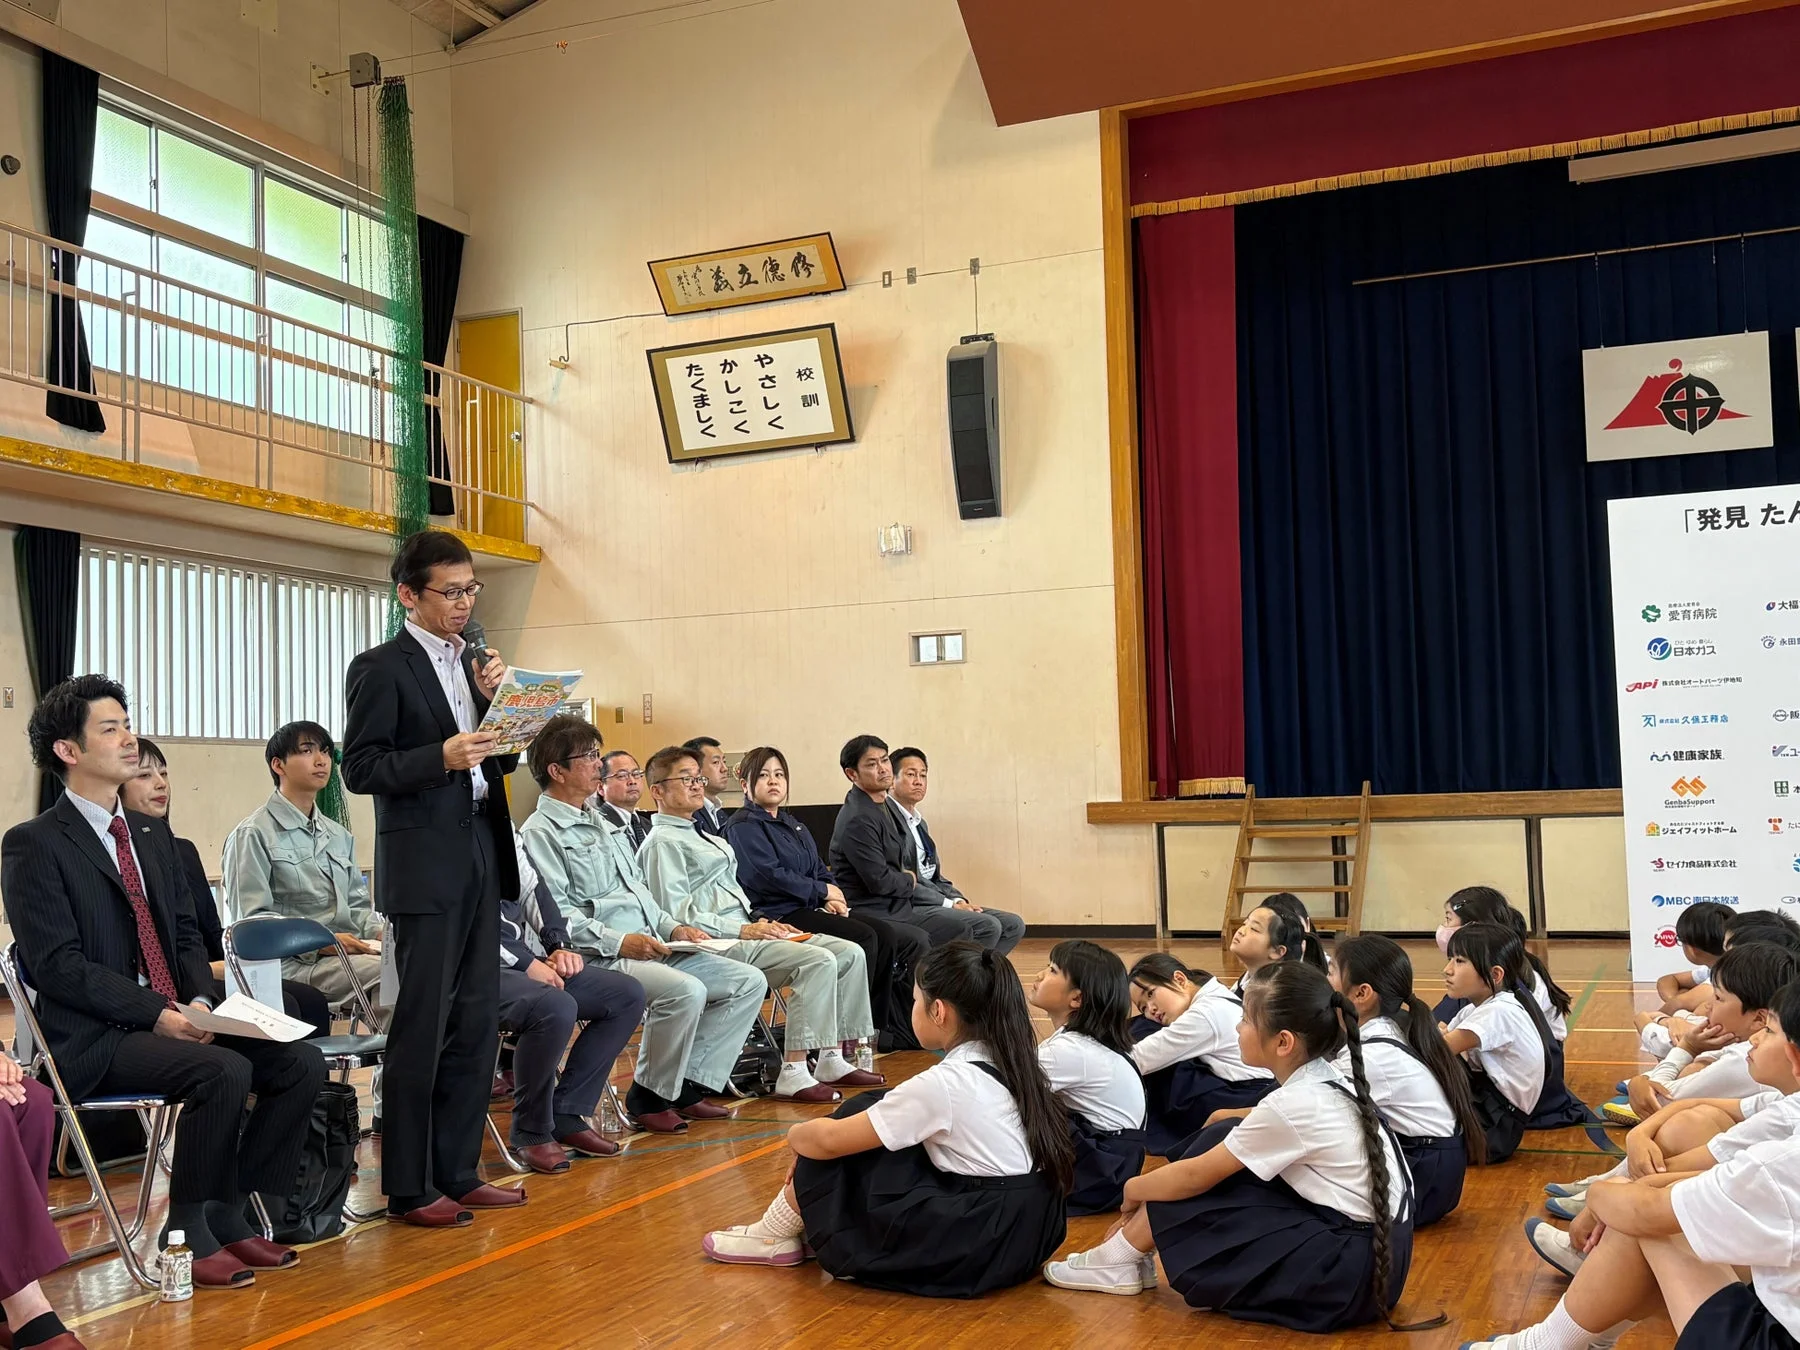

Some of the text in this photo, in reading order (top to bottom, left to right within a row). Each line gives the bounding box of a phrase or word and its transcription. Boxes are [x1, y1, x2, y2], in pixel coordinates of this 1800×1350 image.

[754, 353, 784, 430] やさしく
[796, 367, 820, 408] 校訓
[685, 363, 717, 438] たくましく
[719, 358, 750, 434] かしこく
[1684, 505, 1750, 533] 「発見
[1778, 600, 1800, 611] 大福
[1668, 607, 1718, 621] 愛育病院
[1673, 645, 1717, 656] 日本ガス
[504, 694, 562, 708] 鹿児島市
[1681, 714, 1729, 724] 久保工務店
[1673, 749, 1723, 761] 健康家族
[1664, 798, 1715, 806] GenbaSupport
[1662, 826, 1737, 835] ジェイフィットホーム
[1666, 859, 1738, 869] セイカ食品株式会社
[1666, 896, 1692, 905] MBC
